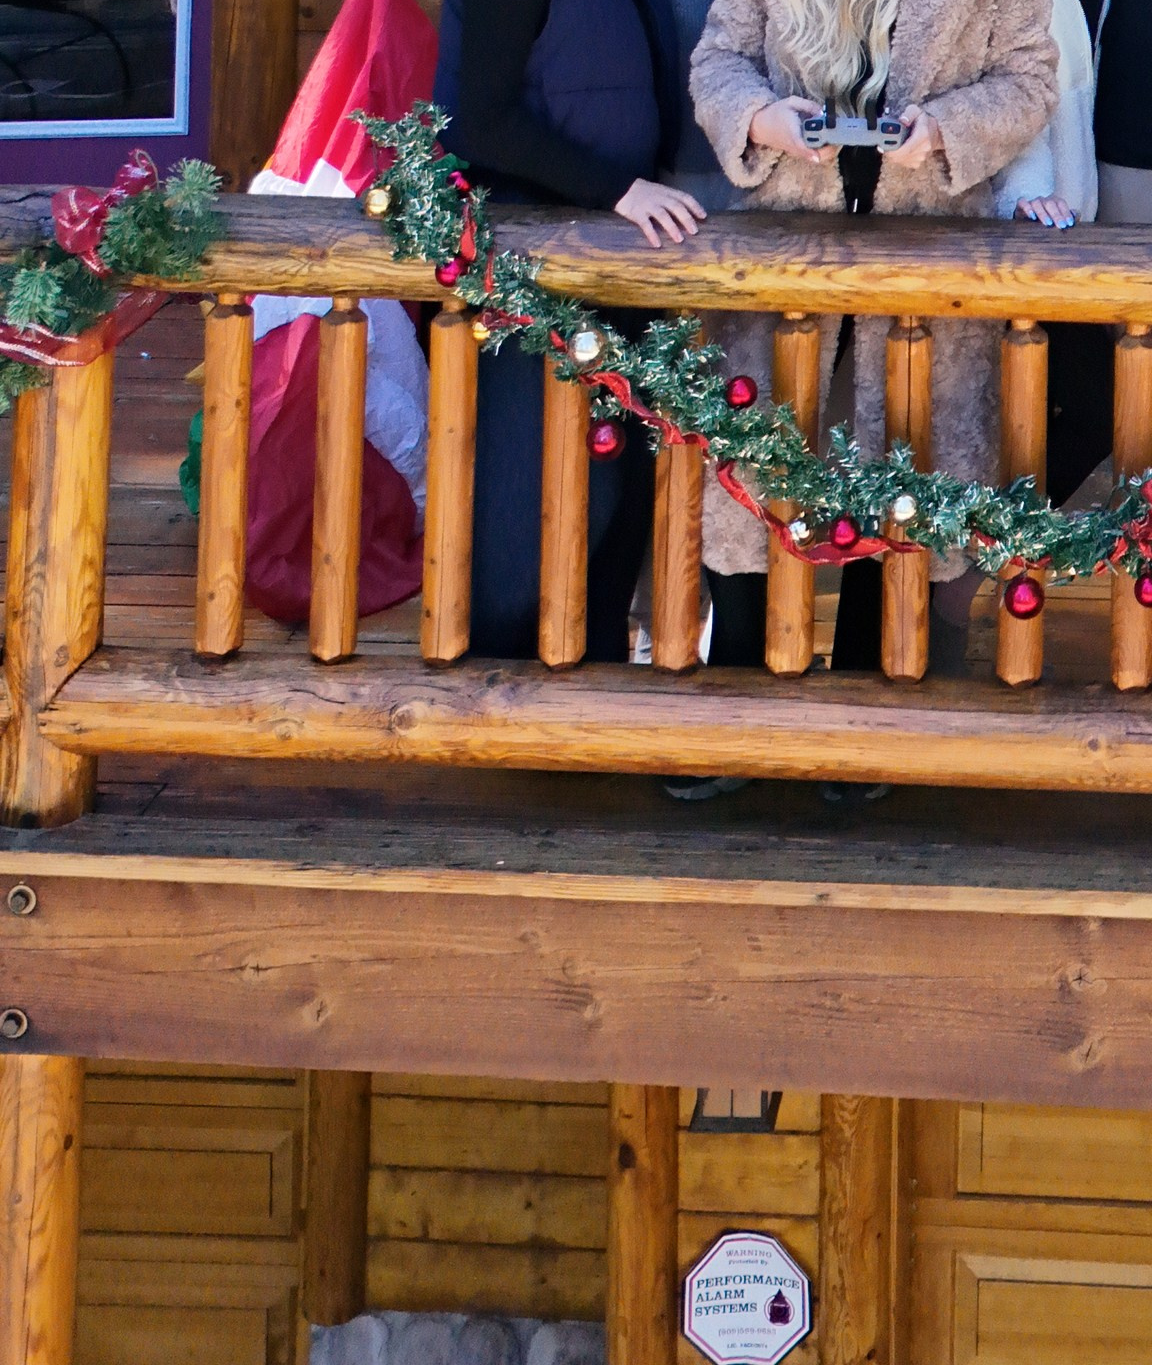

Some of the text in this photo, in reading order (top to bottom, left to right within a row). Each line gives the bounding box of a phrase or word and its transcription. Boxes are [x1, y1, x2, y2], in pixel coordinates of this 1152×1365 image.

[725, 1249, 772, 1259] WARNING
[696, 1274, 800, 1290] PERFORMANCE
[695, 1289, 745, 1304] ALARM
[694, 1302, 758, 1318] SYSTEMS
